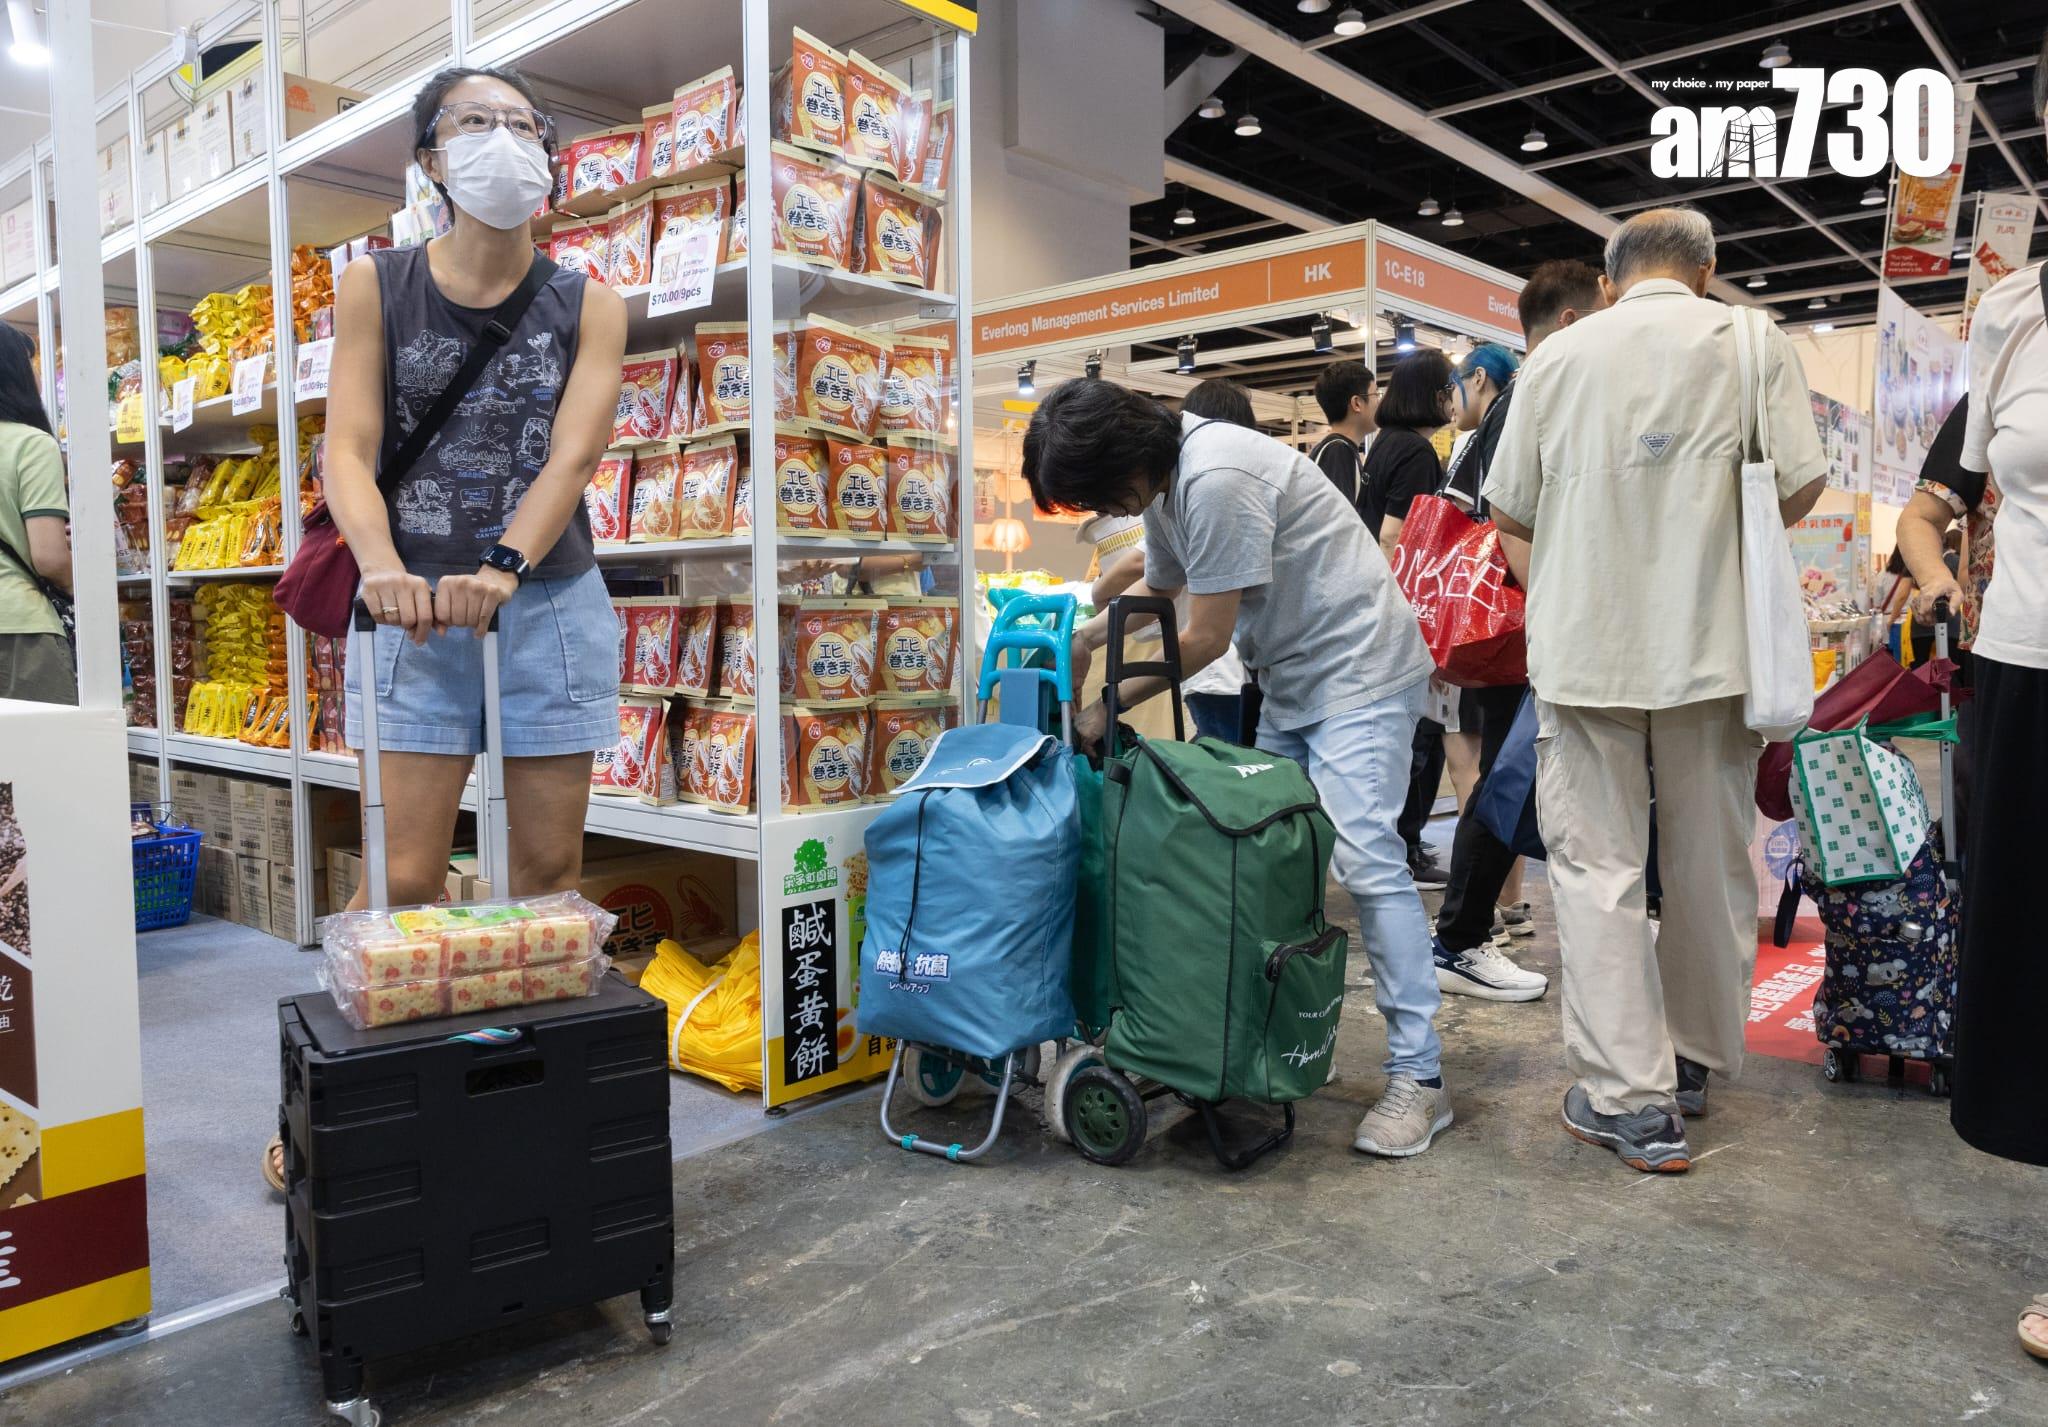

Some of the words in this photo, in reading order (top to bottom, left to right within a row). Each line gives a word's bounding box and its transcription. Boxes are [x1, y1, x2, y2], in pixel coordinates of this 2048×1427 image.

[1303, 261, 1333, 283] HK
[1384, 259, 1426, 288] 1C-E18
[980, 321, 1030, 342] Everlong
[1031, 304, 1109, 333] Management
[1110, 295, 1166, 318] Services
[1167, 283, 1220, 308] Limited
[1487, 295, 1521, 322] Everlon
